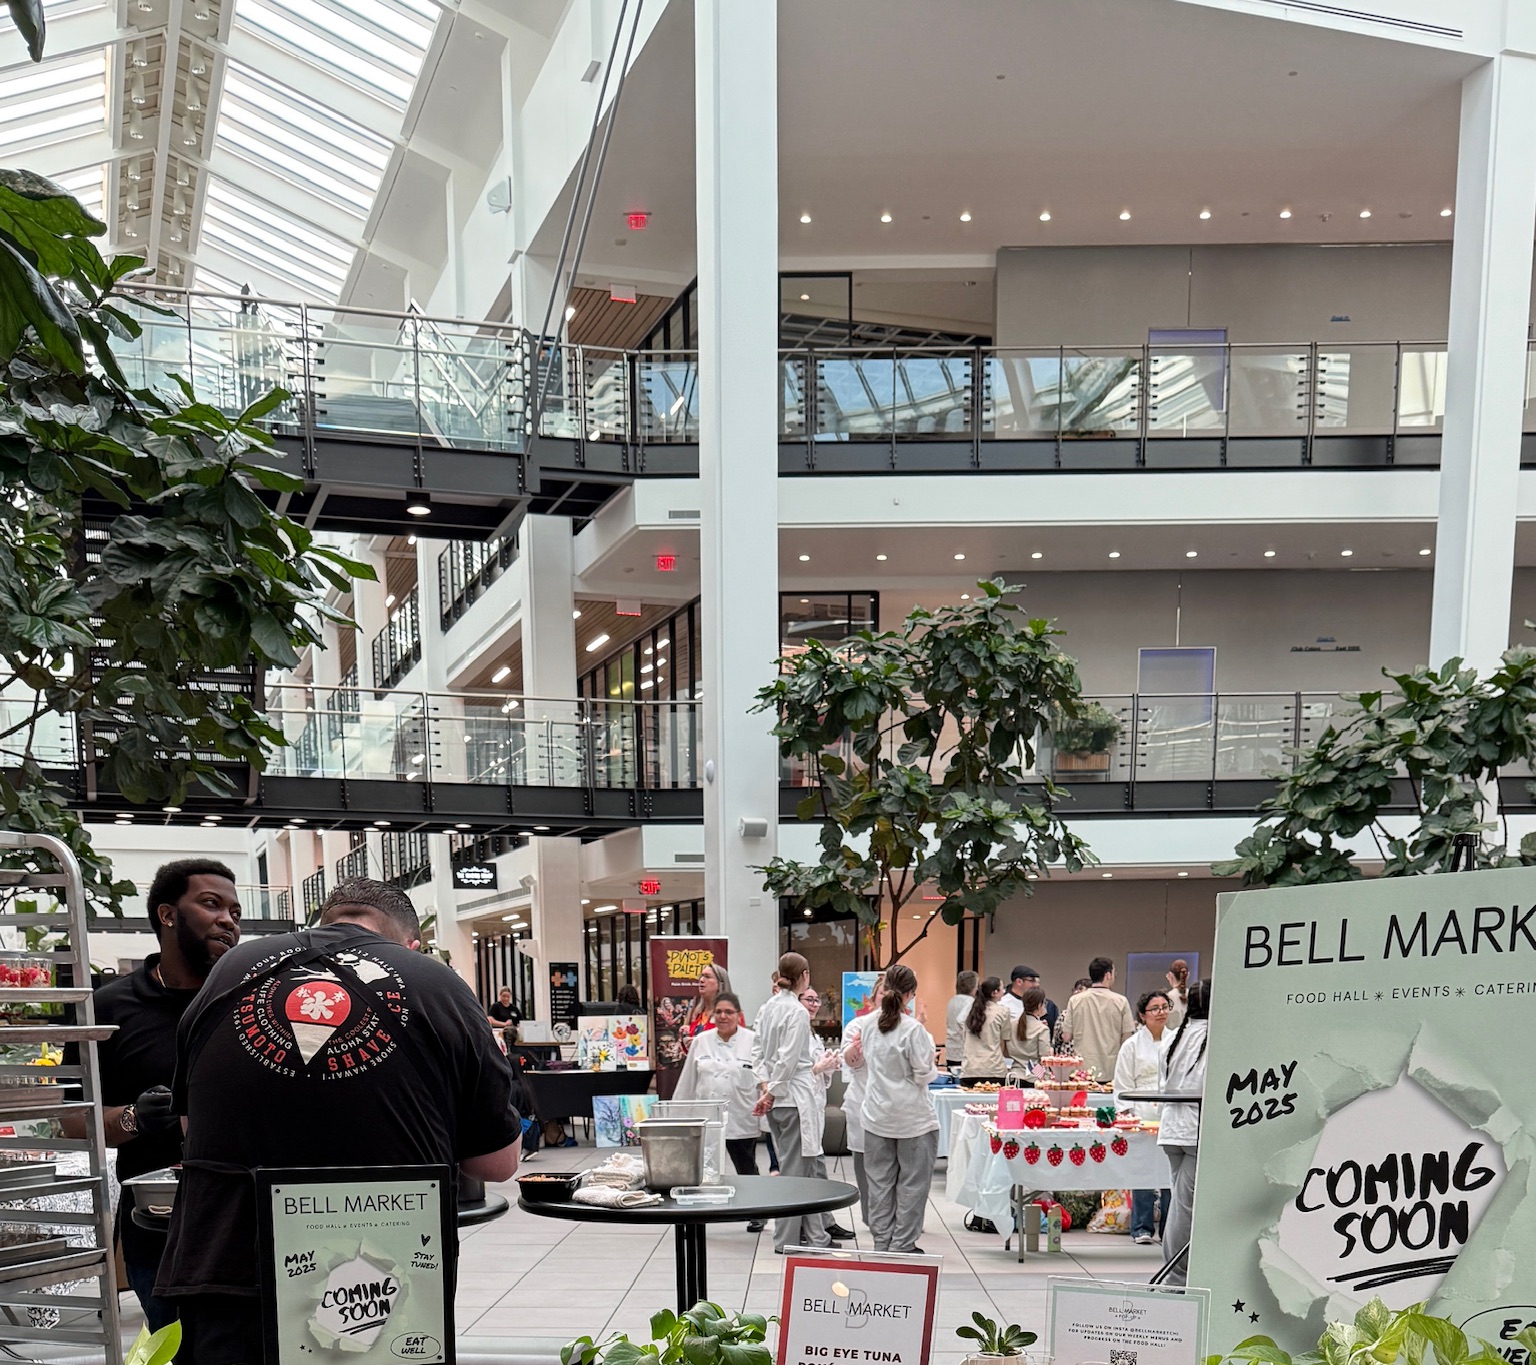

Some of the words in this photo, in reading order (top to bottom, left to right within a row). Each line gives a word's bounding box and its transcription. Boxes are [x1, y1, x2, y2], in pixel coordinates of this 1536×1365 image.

[1244, 918, 1365, 969] BELL
[1383, 904, 1536, 960] MARK
[251, 955, 276, 971] YOUR
[257, 977, 276, 1005] HILIFE
[1286, 992, 1327, 1004] FOOD
[1333, 990, 1369, 1002] HALL
[1392, 986, 1450, 999] EVENTS
[257, 1008, 293, 1050] CLOTHING
[327, 1029, 391, 1072] SHAVE
[386, 991, 401, 1013] CE
[327, 1037, 363, 1055] ALOHA
[362, 1012, 380, 1038] STAT
[239, 1033, 296, 1078] ESTABLISHED
[370, 1041, 397, 1067] SHORE
[1226, 1060, 1298, 1104] MAY
[1230, 1092, 1298, 1129] 2025
[1296, 1142, 1496, 1212] COMING
[284, 1196, 338, 1215] BELL
[344, 1193, 428, 1213] MARKET
[1333, 1200, 1469, 1258] SOON
[284, 1250, 315, 1267] MAY
[410, 1261, 439, 1270] TUNED!
[413, 1252, 435, 1261] STAY
[287, 1263, 317, 1277] 2025
[321, 1277, 397, 1308] COMING
[338, 1299, 391, 1324] SOON
[803, 1298, 840, 1314] BELL
[848, 1302, 912, 1319] MARKET
[401, 1346, 426, 1355] WELL
[405, 1336, 429, 1346] EAT
[804, 1345, 828, 1357] BIG
[833, 1348, 859, 1360] EYE
[863, 1350, 902, 1363] TUNA
